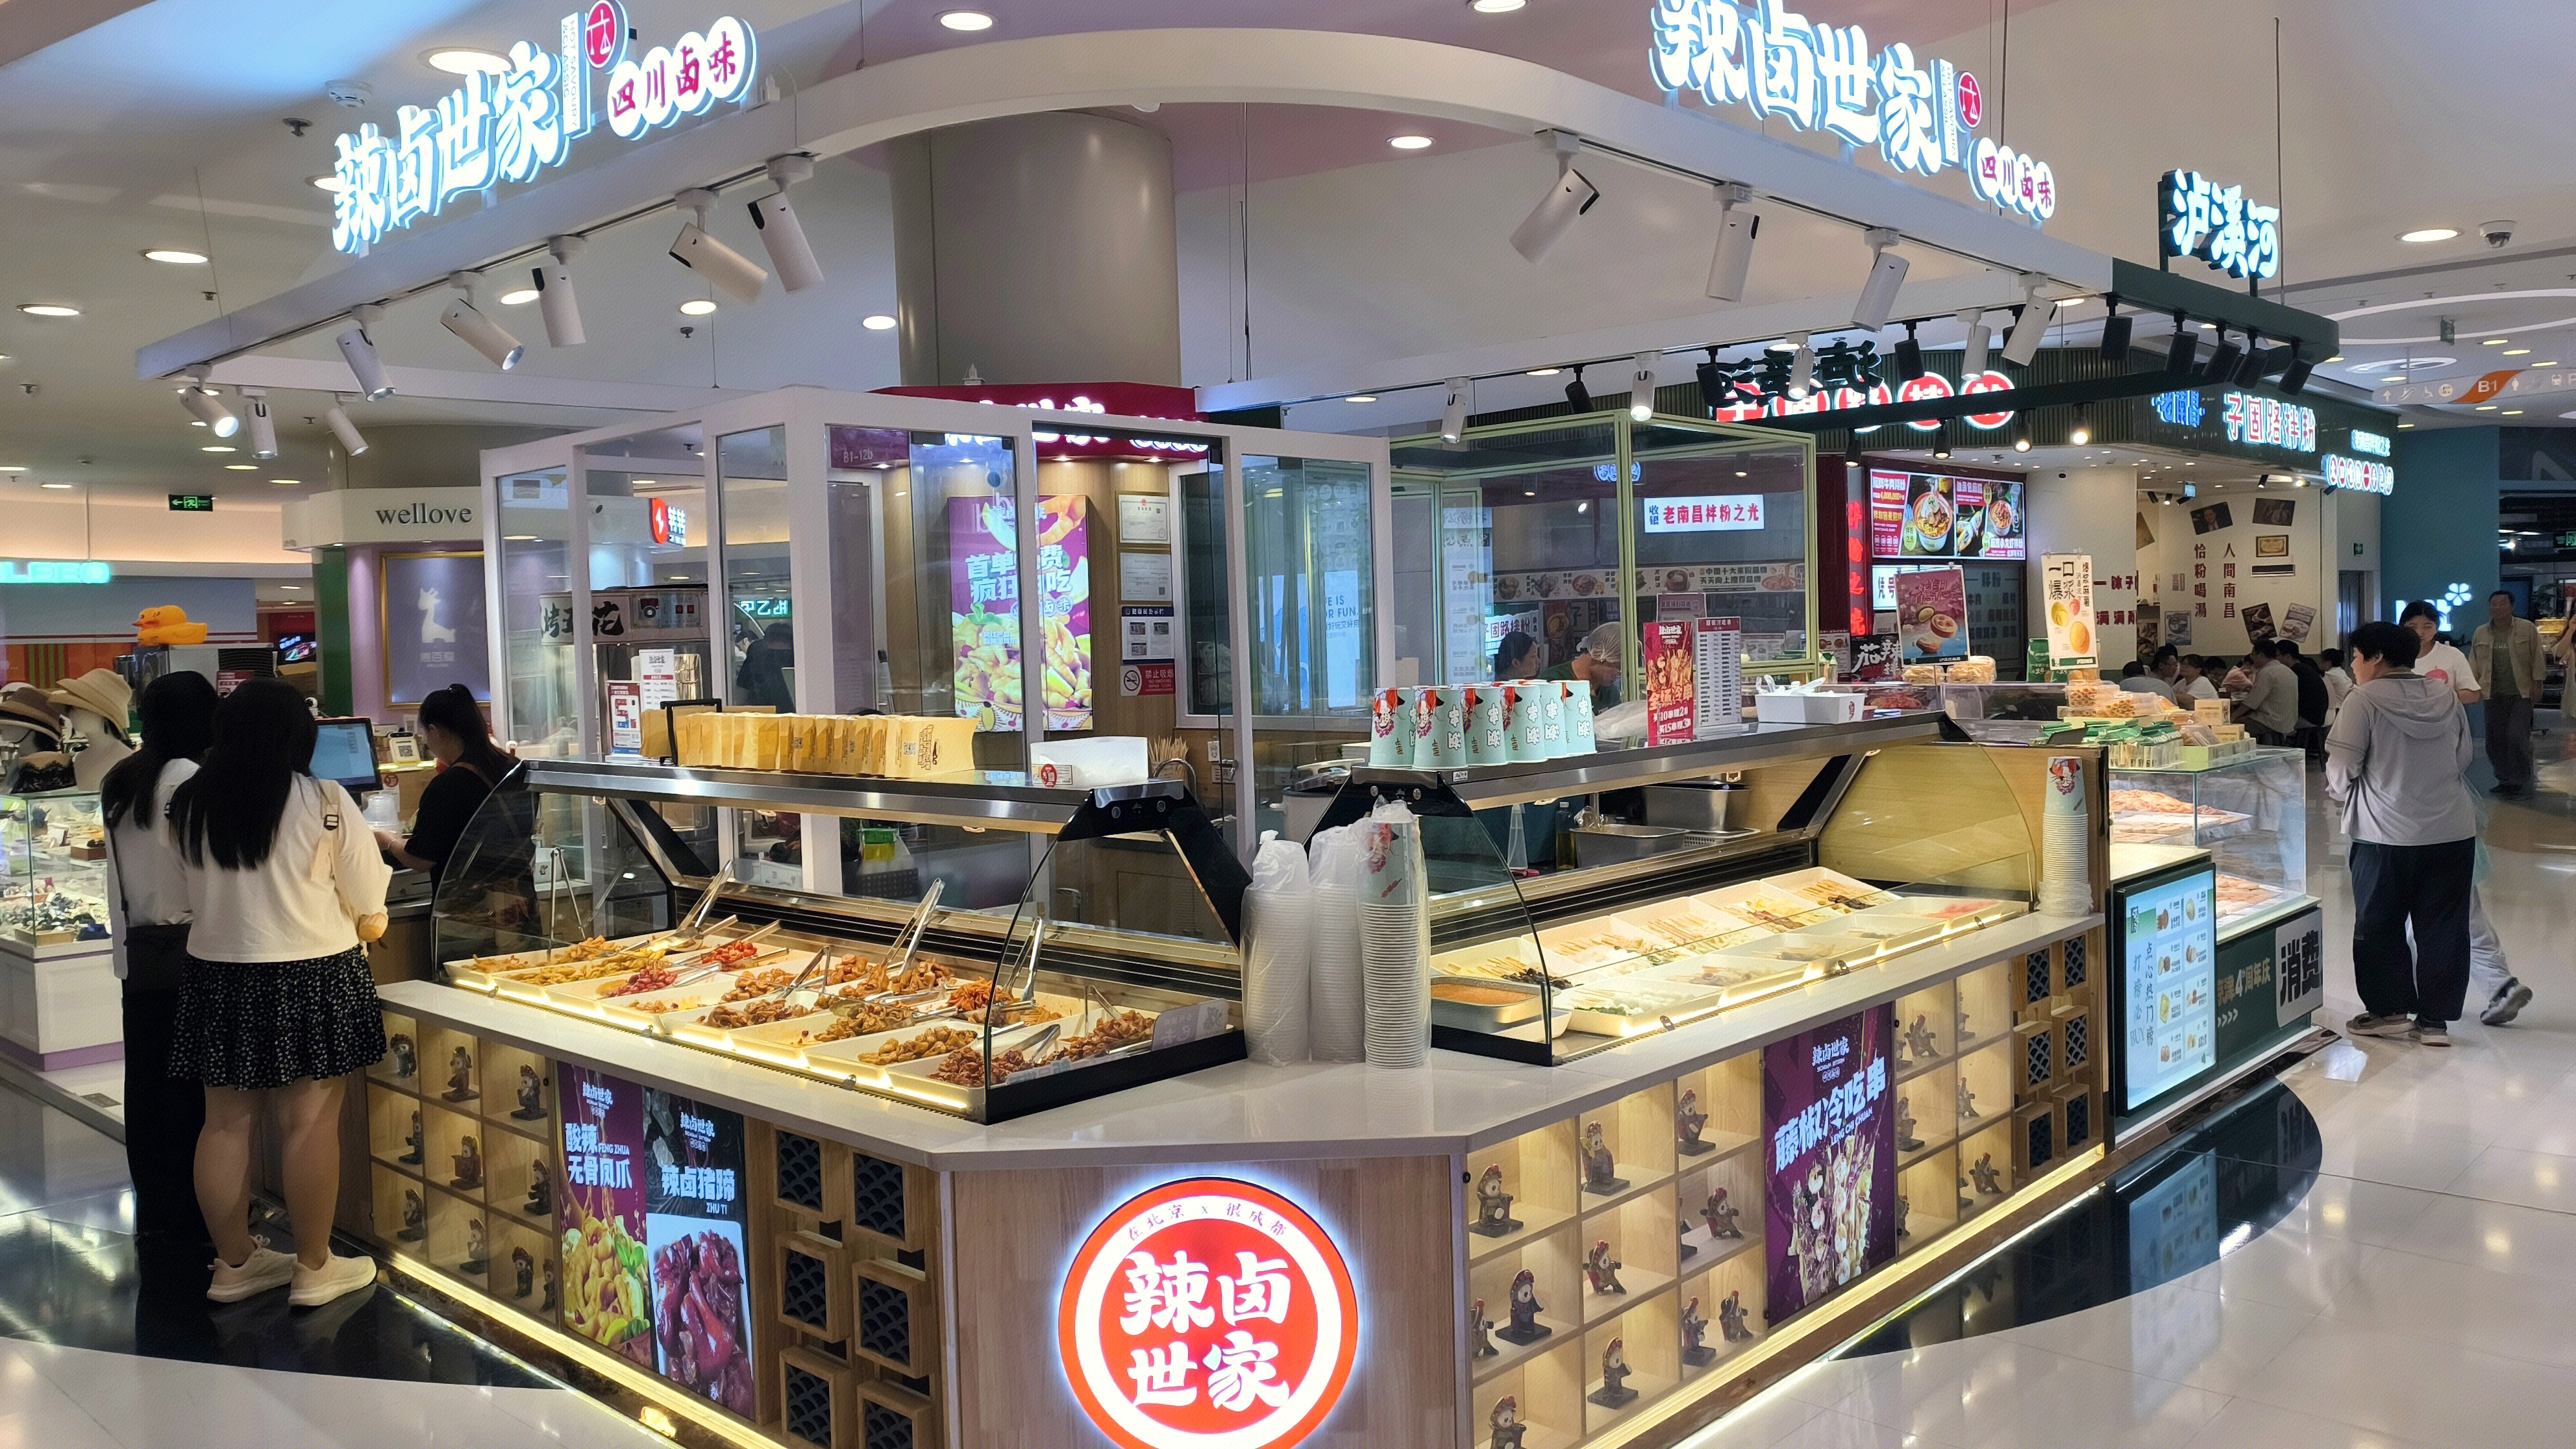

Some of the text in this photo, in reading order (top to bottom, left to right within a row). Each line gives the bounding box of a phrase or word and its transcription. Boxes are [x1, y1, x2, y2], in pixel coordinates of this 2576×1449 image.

[612, 31, 737, 117] 四川卤味
[1650, 0, 1943, 176] 辣卤世家
[332, 41, 566, 253] 辣卤世家
[1981, 155, 2052, 209] 四川卤味
[2172, 167, 2279, 279] 泸溪河
[2478, 380, 2497, 393] B1
[2223, 391, 2316, 452] 子固路拌粉
[375, 502, 473, 525] wellove
[1649, 505, 1659, 525] 收银
[1663, 502, 1759, 525] 老南昌拌粉之光
[965, 545, 1063, 579] 首单费
[2049, 561, 2074, 577] 一口
[970, 568, 1072, 604] 疯狂吃
[2194, 543, 2207, 618] 恰粉喝湯
[2223, 543, 2236, 618] 人間南昌
[1336, 595, 1344, 605] IS
[1337, 606, 1359, 617] FUN.
[1145, 669, 1174, 679] 禁止吸烟
[2280, 930, 2321, 1007] 消费
[1812, 1036, 1850, 1067] 辣卤世家
[680, 1111, 715, 1138] 辣卤世家
[1774, 1056, 1886, 1175] 藤椒冷吃串
[1831, 1106, 1873, 1146] LENG CHI CHUAN
[565, 1122, 599, 1154] 酸辣
[598, 1143, 630, 1156] FENG ZHUA
[567, 1155, 633, 1189] 无骨凤爪
[661, 1164, 736, 1202] 辣卤猪蹄
[706, 1202, 728, 1215] ZHU TI
[1128, 1203, 1185, 1241] 在北京
[1226, 1202, 1287, 1237] 很成都
[1119, 1250, 1291, 1336] 辣卤
[1126, 1330, 1291, 1412] 世家
